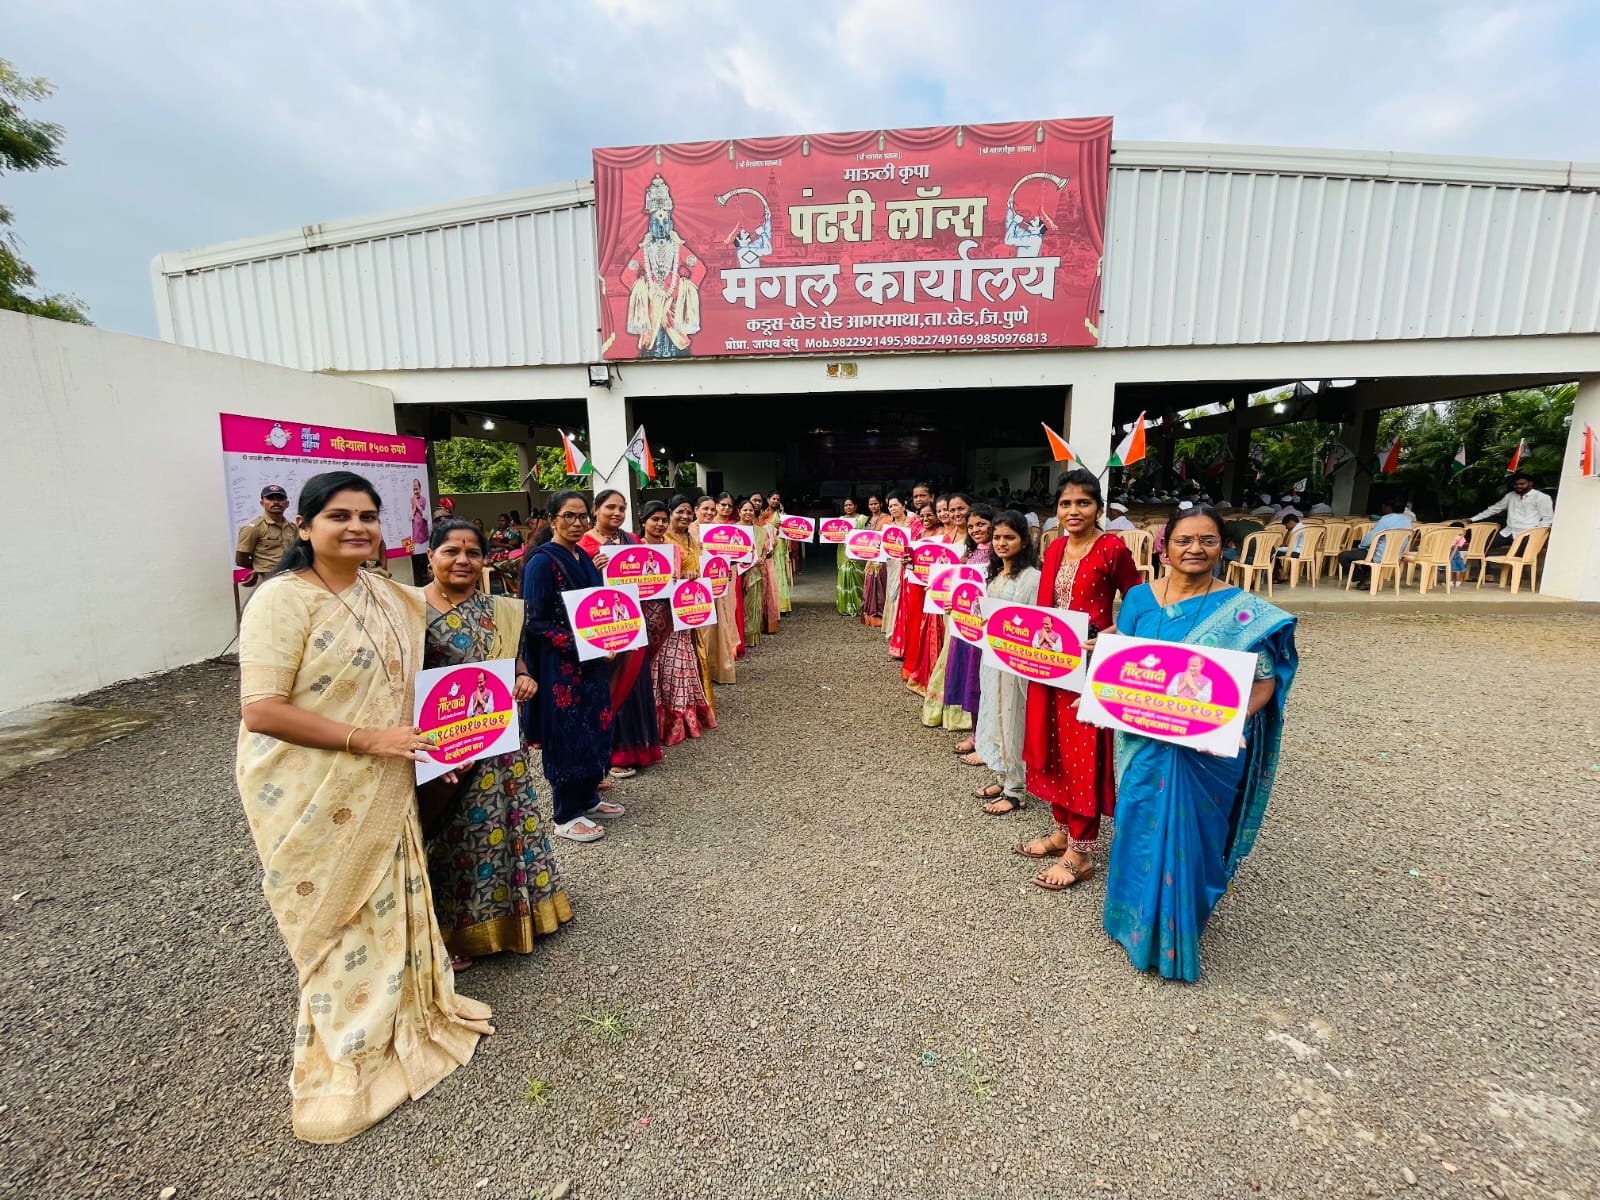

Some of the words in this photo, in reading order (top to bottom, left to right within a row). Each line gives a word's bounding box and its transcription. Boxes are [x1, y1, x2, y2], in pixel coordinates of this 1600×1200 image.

[843, 163, 895, 182] माऊली
[899, 164, 930, 184] कृपा
[788, 187, 876, 244] पंढरी
[885, 185, 988, 240] लॉन्स
[852, 239, 1061, 305] कार्यालय
[819, 311, 843, 330] रोड
[368, 442, 389, 454] १५००
